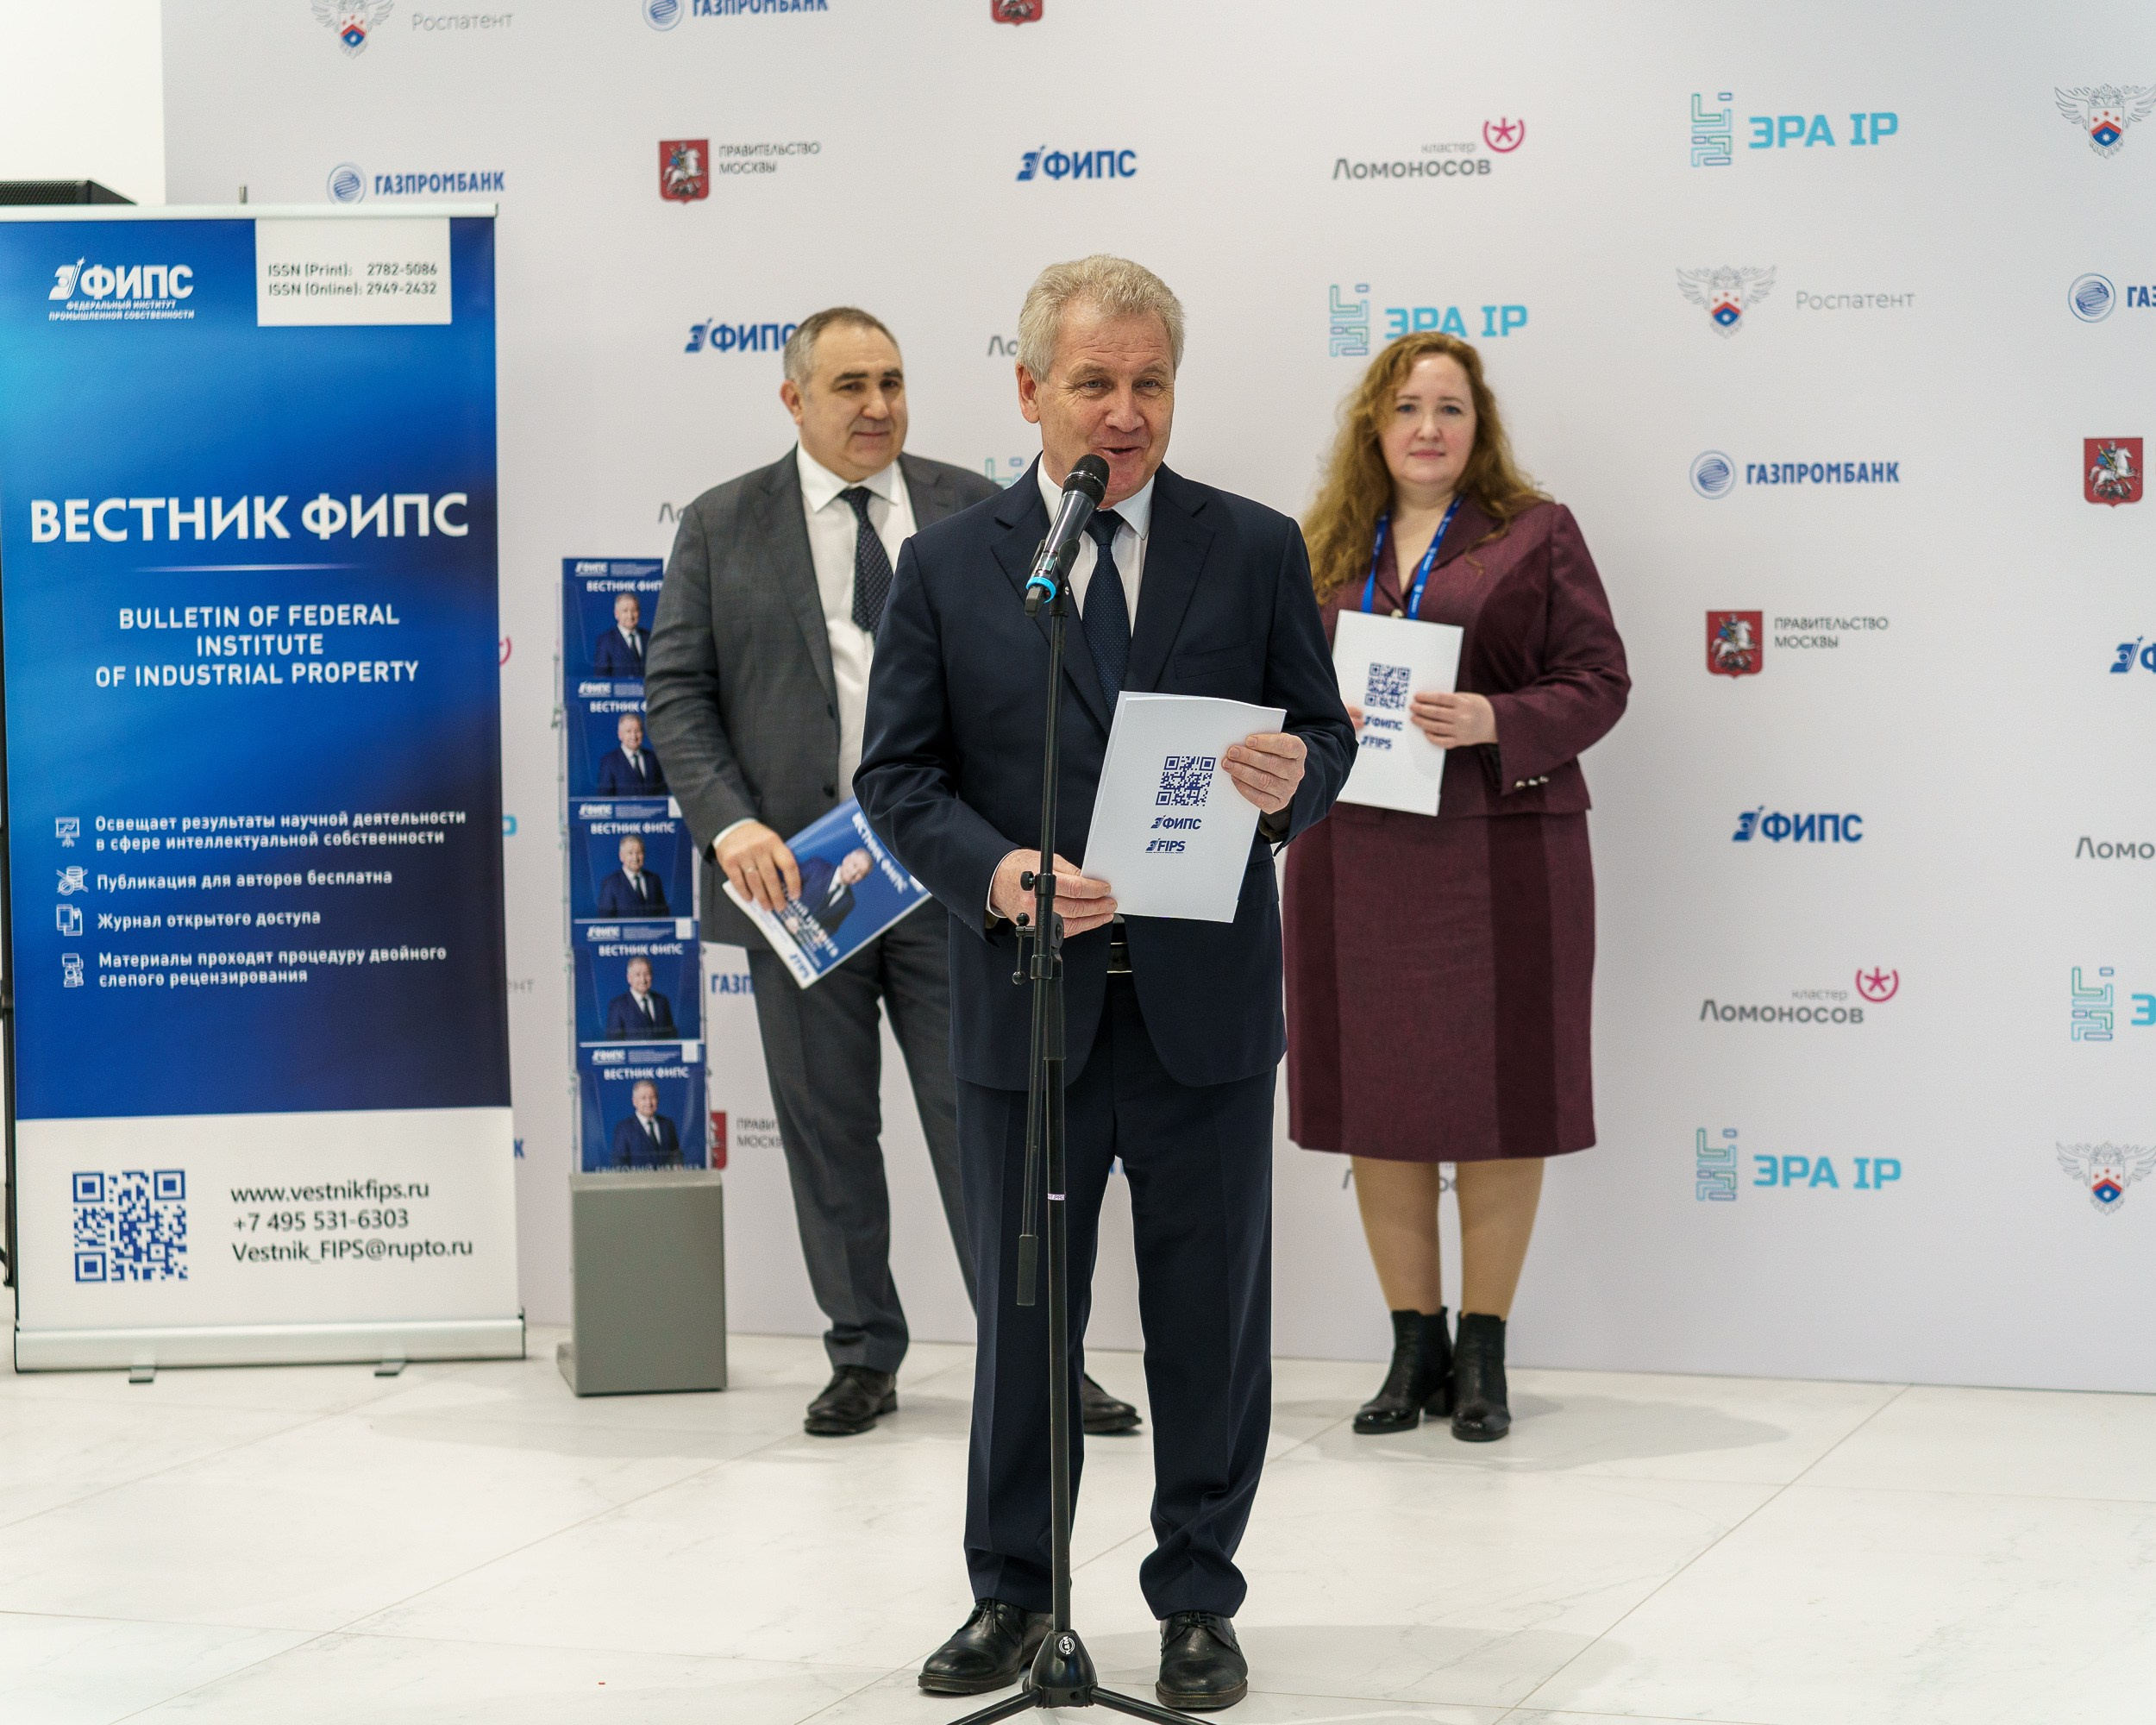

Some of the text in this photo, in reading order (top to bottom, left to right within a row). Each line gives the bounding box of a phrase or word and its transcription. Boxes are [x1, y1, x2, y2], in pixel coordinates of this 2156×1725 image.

[411, 12, 513, 32] Роспатент
[1748, 112, 1899, 148] ЭРА IP
[718, 141, 822, 157] ПРАВИТЕЛЬСТВО
[1421, 142, 1476, 154] кластер
[718, 160, 777, 175] МОСКВЫ
[1043, 149, 1138, 179] ФИПС
[1332, 157, 1492, 179] Ломоносов
[374, 171, 505, 195] ГАЗПРОМБАНК
[268, 263, 301, 277] ISSN
[367, 262, 437, 277] 2782-5086
[80, 264, 194, 300] ФИПС
[268, 283, 302, 297] ISSN
[366, 281, 437, 296] 2949-2432
[66, 300, 176, 310] ФЕДЕРАЛЬНЫЙ ИНСТИТУТ
[1796, 289, 1915, 311] Роспатент
[48, 310, 195, 322] ПРОМЫШЛЕННОЙ СОБСТВЕННОСТИ
[1481, 305, 1528, 337] IP
[1746, 461, 1900, 486] ГАЗПРОМБАНК
[31, 492, 469, 543] ВЕСТНИК ФИПС
[120, 605, 399, 630] BULLETIN OF FEDERAL
[1774, 616, 1890, 631] ПРАВИТЕЛЬСТВО
[197, 634, 324, 656] INSTITUTE
[1774, 635, 1839, 649] МОСКВЫ
[96, 661, 419, 687] OF INDUSTRIAL PROPERTY
[96, 809, 466, 833] Освещает результаты научной деятельности
[1163, 818, 1201, 830] ФИПС
[1761, 812, 1864, 844] ФИПС
[96, 829, 444, 854] в сфере интеллектуальной собственности
[1156, 840, 1186, 852] FIPS
[97, 869, 392, 893] Публикация для авторов бесплатна
[97, 910, 321, 932] Журнал открытого доступа
[99, 944, 446, 969] Материалы проходят процедуру двойного
[99, 968, 307, 990] слепого рецензирования
[1791, 988, 1848, 1001] кластер
[1699, 999, 1864, 1024] Ломоносов
[1752, 1153, 1902, 1189] ЭРА IP
[230, 1178, 429, 1204] www.vestnikfips.ru
[233, 1208, 410, 1233] +7 495 531-6303
[232, 1238, 473, 1264] Vestnik_FIPS@rupto.ru
